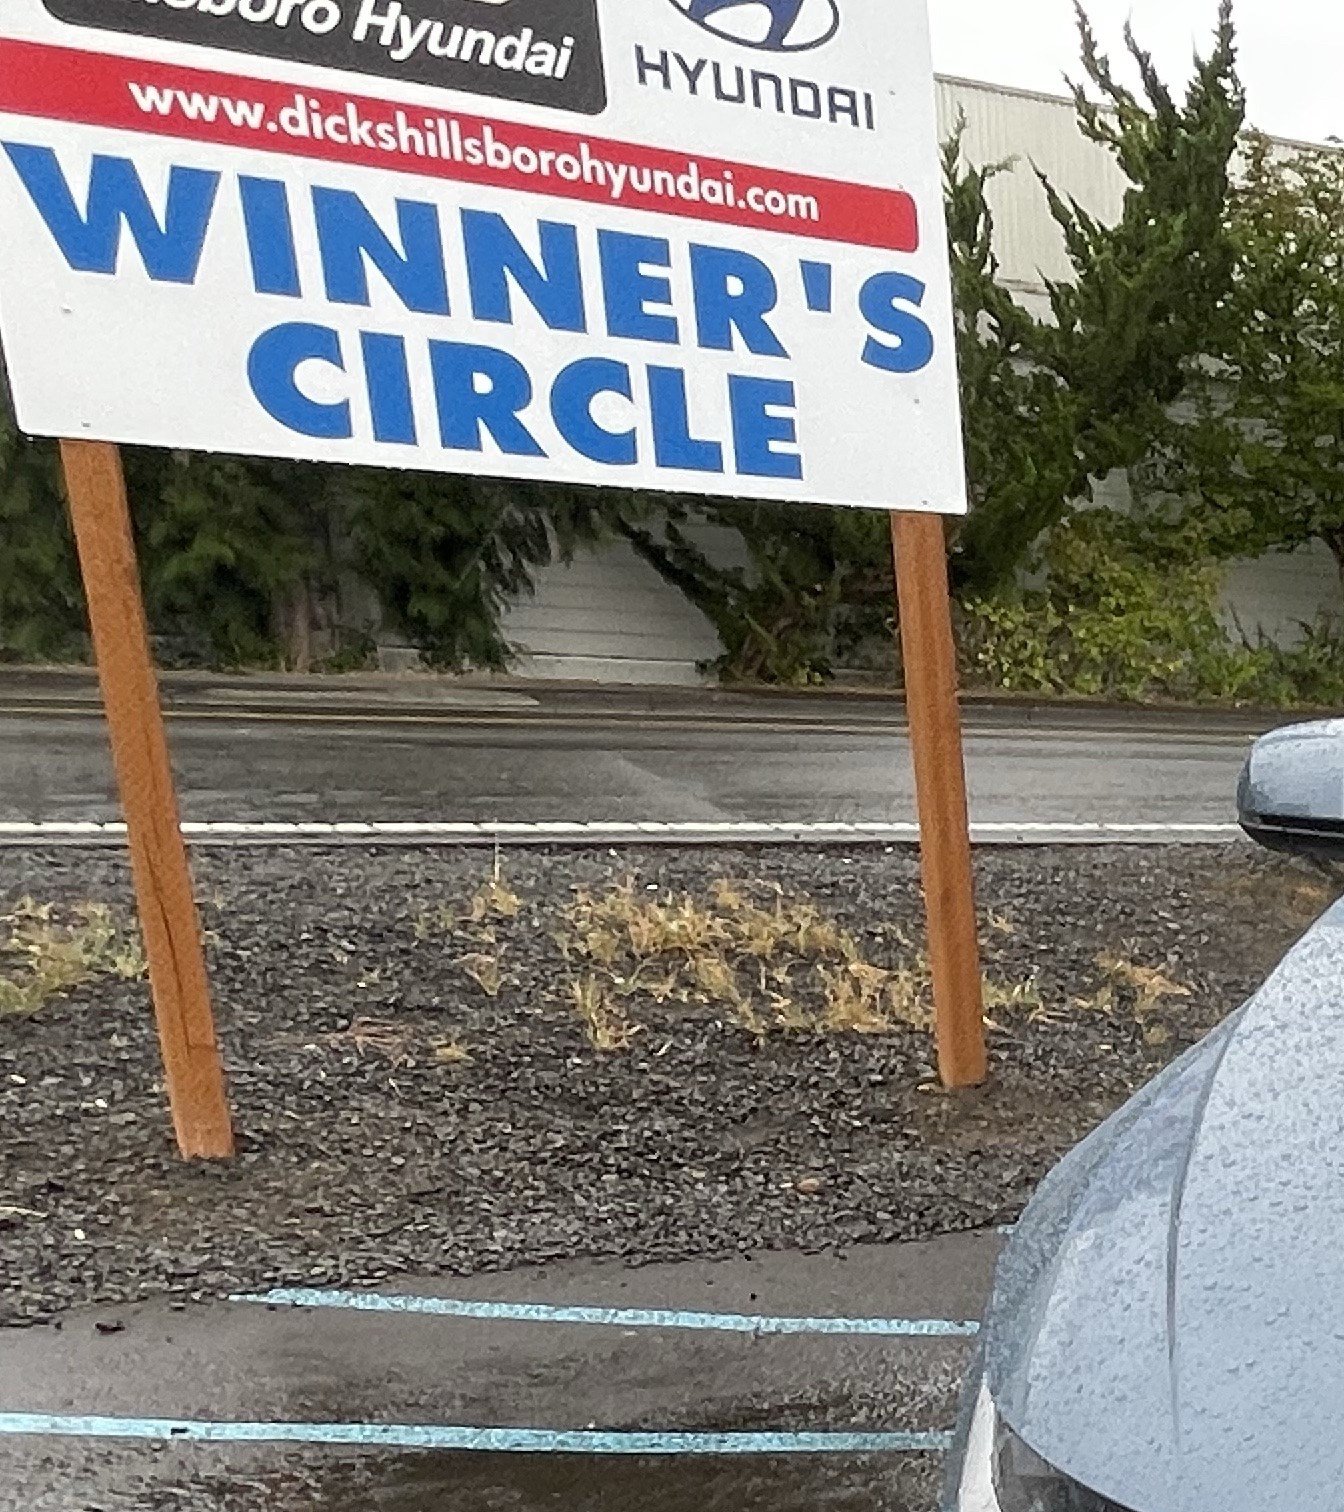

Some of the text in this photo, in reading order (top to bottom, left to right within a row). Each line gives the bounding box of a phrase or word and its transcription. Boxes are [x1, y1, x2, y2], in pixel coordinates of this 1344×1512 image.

[352, 0, 575, 81] Hyundai
[633, 45, 875, 130] HYUNDAI
[128, 83, 820, 221] www.dickshillsborohyundai.com
[2, 142, 935, 374] WINNER'S
[247, 322, 803, 481] CIRCLE
